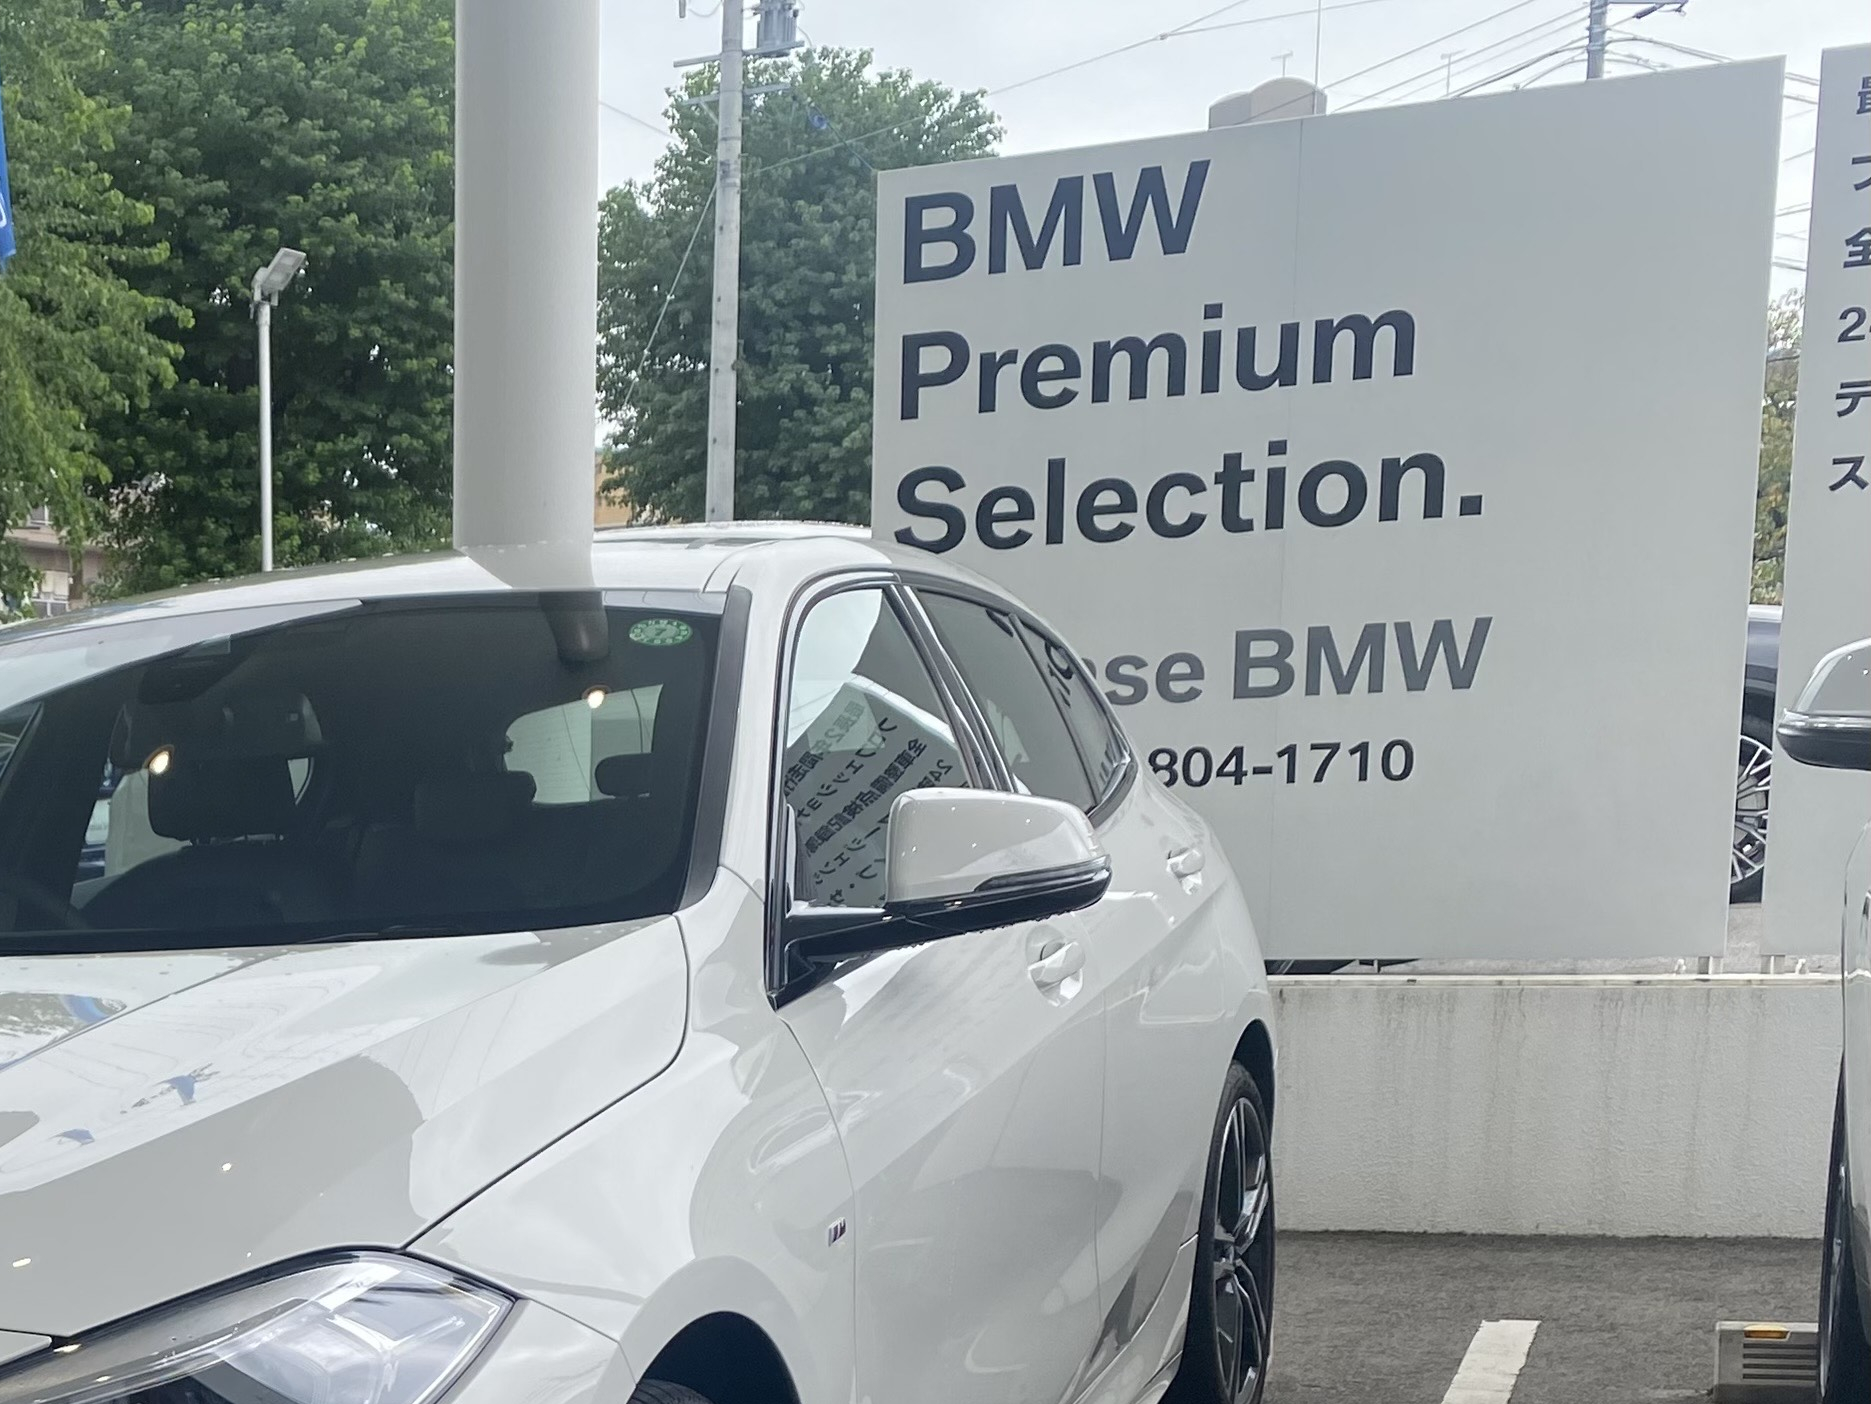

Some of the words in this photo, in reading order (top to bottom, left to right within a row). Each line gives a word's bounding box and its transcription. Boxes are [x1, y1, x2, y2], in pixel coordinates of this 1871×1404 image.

[903, 159, 1211, 285] BMW
[901, 302, 1415, 420] Premium
[894, 439, 1482, 554] Selection.
[1233, 616, 1493, 700] BMW
